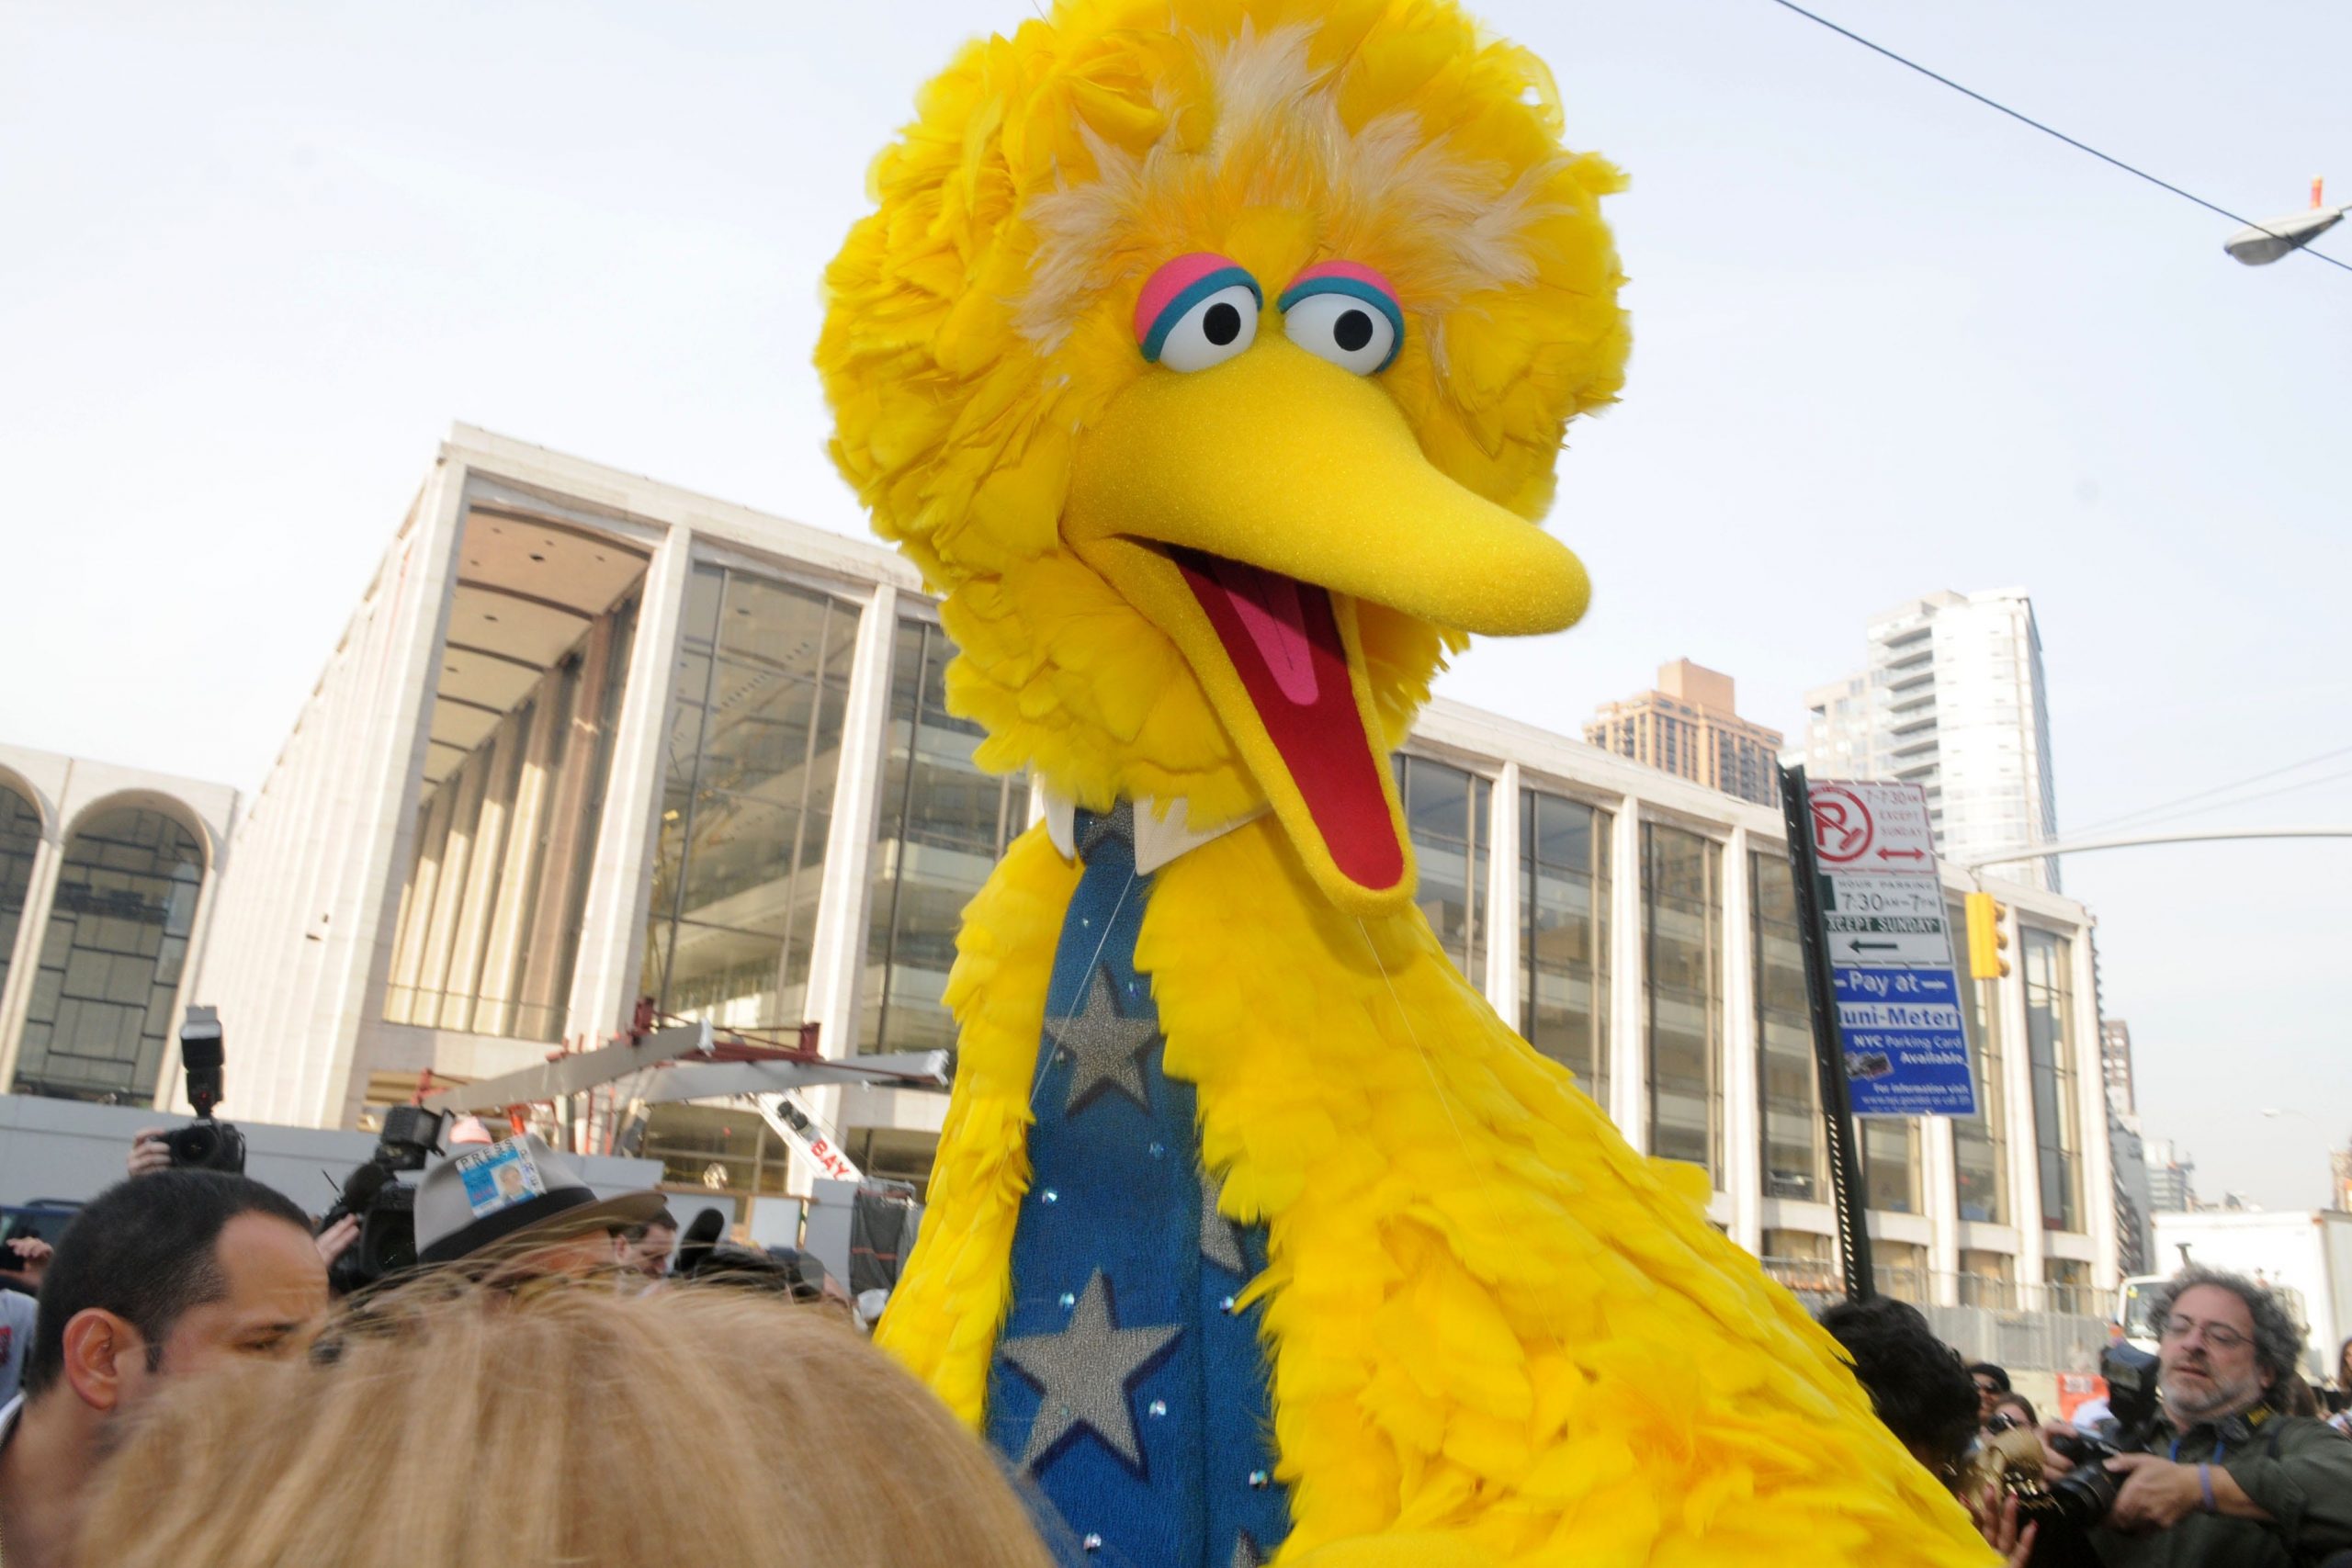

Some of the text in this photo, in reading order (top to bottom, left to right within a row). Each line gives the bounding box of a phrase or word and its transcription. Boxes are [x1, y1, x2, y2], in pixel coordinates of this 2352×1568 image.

[1879, 810, 1919, 821] EXCEPT
[1881, 827, 1923, 837] SUNDAY
[1838, 880, 1933, 890] HOUR PARKING
[1826, 916, 1939, 933] XCEPT SUNDAY
[1849, 970, 1920, 998] Pay at
[1838, 1005, 1954, 1026] uni-Meter
[1853, 1034, 1962, 1050] NYC Parking Card
[1899, 1051, 1965, 1065] Available
[1873, 1083, 1969, 1095] For information visit
[460, 1139, 514, 1170] PRESS
[810, 1138, 850, 1181] BAY
